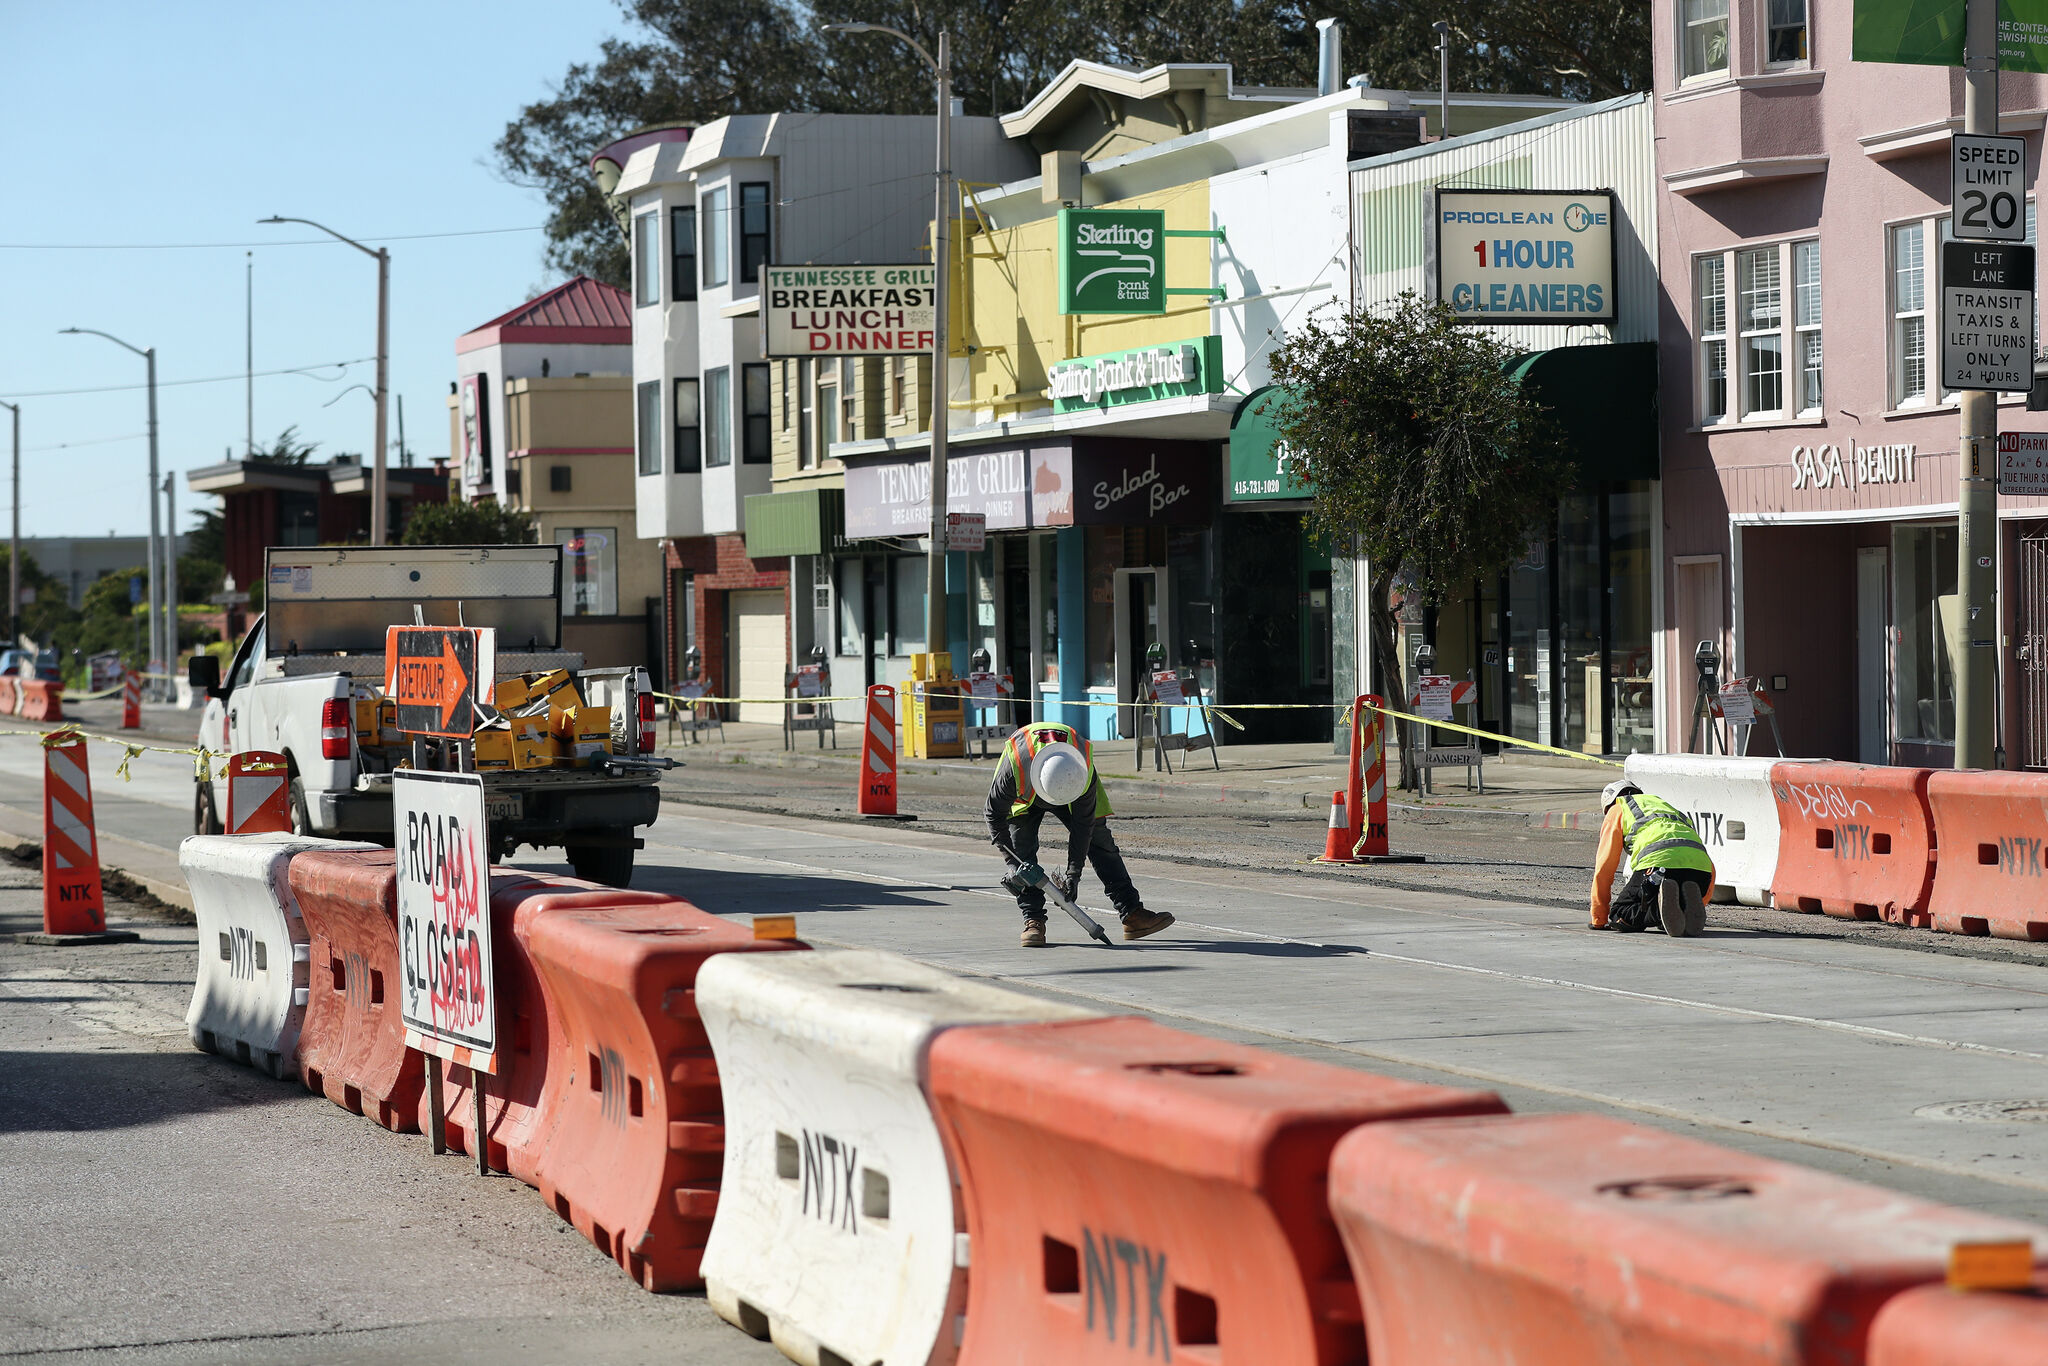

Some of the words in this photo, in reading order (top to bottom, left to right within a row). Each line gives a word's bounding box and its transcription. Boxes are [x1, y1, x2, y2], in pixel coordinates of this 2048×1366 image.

[1998, 20, 2011, 31] HE
[1999, 48, 2026, 58] cjm.org
[1959, 147, 2020, 165] SPEED
[1965, 168, 2013, 185] LIMIT
[1443, 211, 1553, 225] PROCLEAN
[1961, 189, 2017, 229] 20
[1076, 223, 1154, 249] Sterling
[1473, 240, 1487, 267] 1
[1493, 239, 1574, 269] HOUR
[1974, 252, 2003, 265] LEFT
[769, 270, 877, 287] TENNESSEE
[1117, 280, 1149, 290] bank
[1972, 270, 2005, 283] LANE
[771, 288, 935, 309] BREAKFAST
[1452, 283, 1604, 313] CLEANERS
[1955, 294, 2023, 310] TRANSIT
[791, 310, 905, 330] LUNCH
[1957, 313, 2004, 328] TAXIS
[2010, 316, 2020, 329] &
[809, 330, 935, 351] DINNER
[1951, 332, 1980, 346] LEFT
[1987, 334, 2026, 349] TURNS
[1966, 352, 2011, 366] ONLY
[1047, 363, 1094, 403] Sterling
[1095, 353, 1136, 393] Bank
[1135, 351, 1147, 388] &
[1148, 345, 1190, 384] Trust
[1957, 370, 1972, 380] 24
[1980, 371, 2020, 383] HOURS
[2000, 434, 2018, 450] NO
[1791, 443, 1846, 489] SASA
[1856, 444, 1914, 483] BEAUTY
[2006, 456, 2013, 468] 2
[2035, 456, 2042, 468] 6
[1093, 453, 1160, 510] Salad
[2004, 472, 2019, 483] TUE
[2020, 473, 2041, 483] THUR
[1234, 479, 1280, 495] 415-731-1020
[1149, 483, 1190, 517] Bar
[891, 505, 932, 525] BREAKFAST
[985, 500, 1014, 518] DINNER
[401, 663, 445, 700] DETOUR
[1425, 753, 1470, 765] RANGER
[870, 785, 891, 796] NTK
[408, 810, 462, 890] ROAD
[1834, 824, 1870, 861] NTK
[2000, 836, 2042, 877] NTK
[60, 884, 91, 902] NTK
[229, 926, 254, 982] NTK
[405, 914, 482, 1005] CLOSED
[802, 1128, 858, 1236] NTK
[1082, 1224, 1172, 1365] NTK
